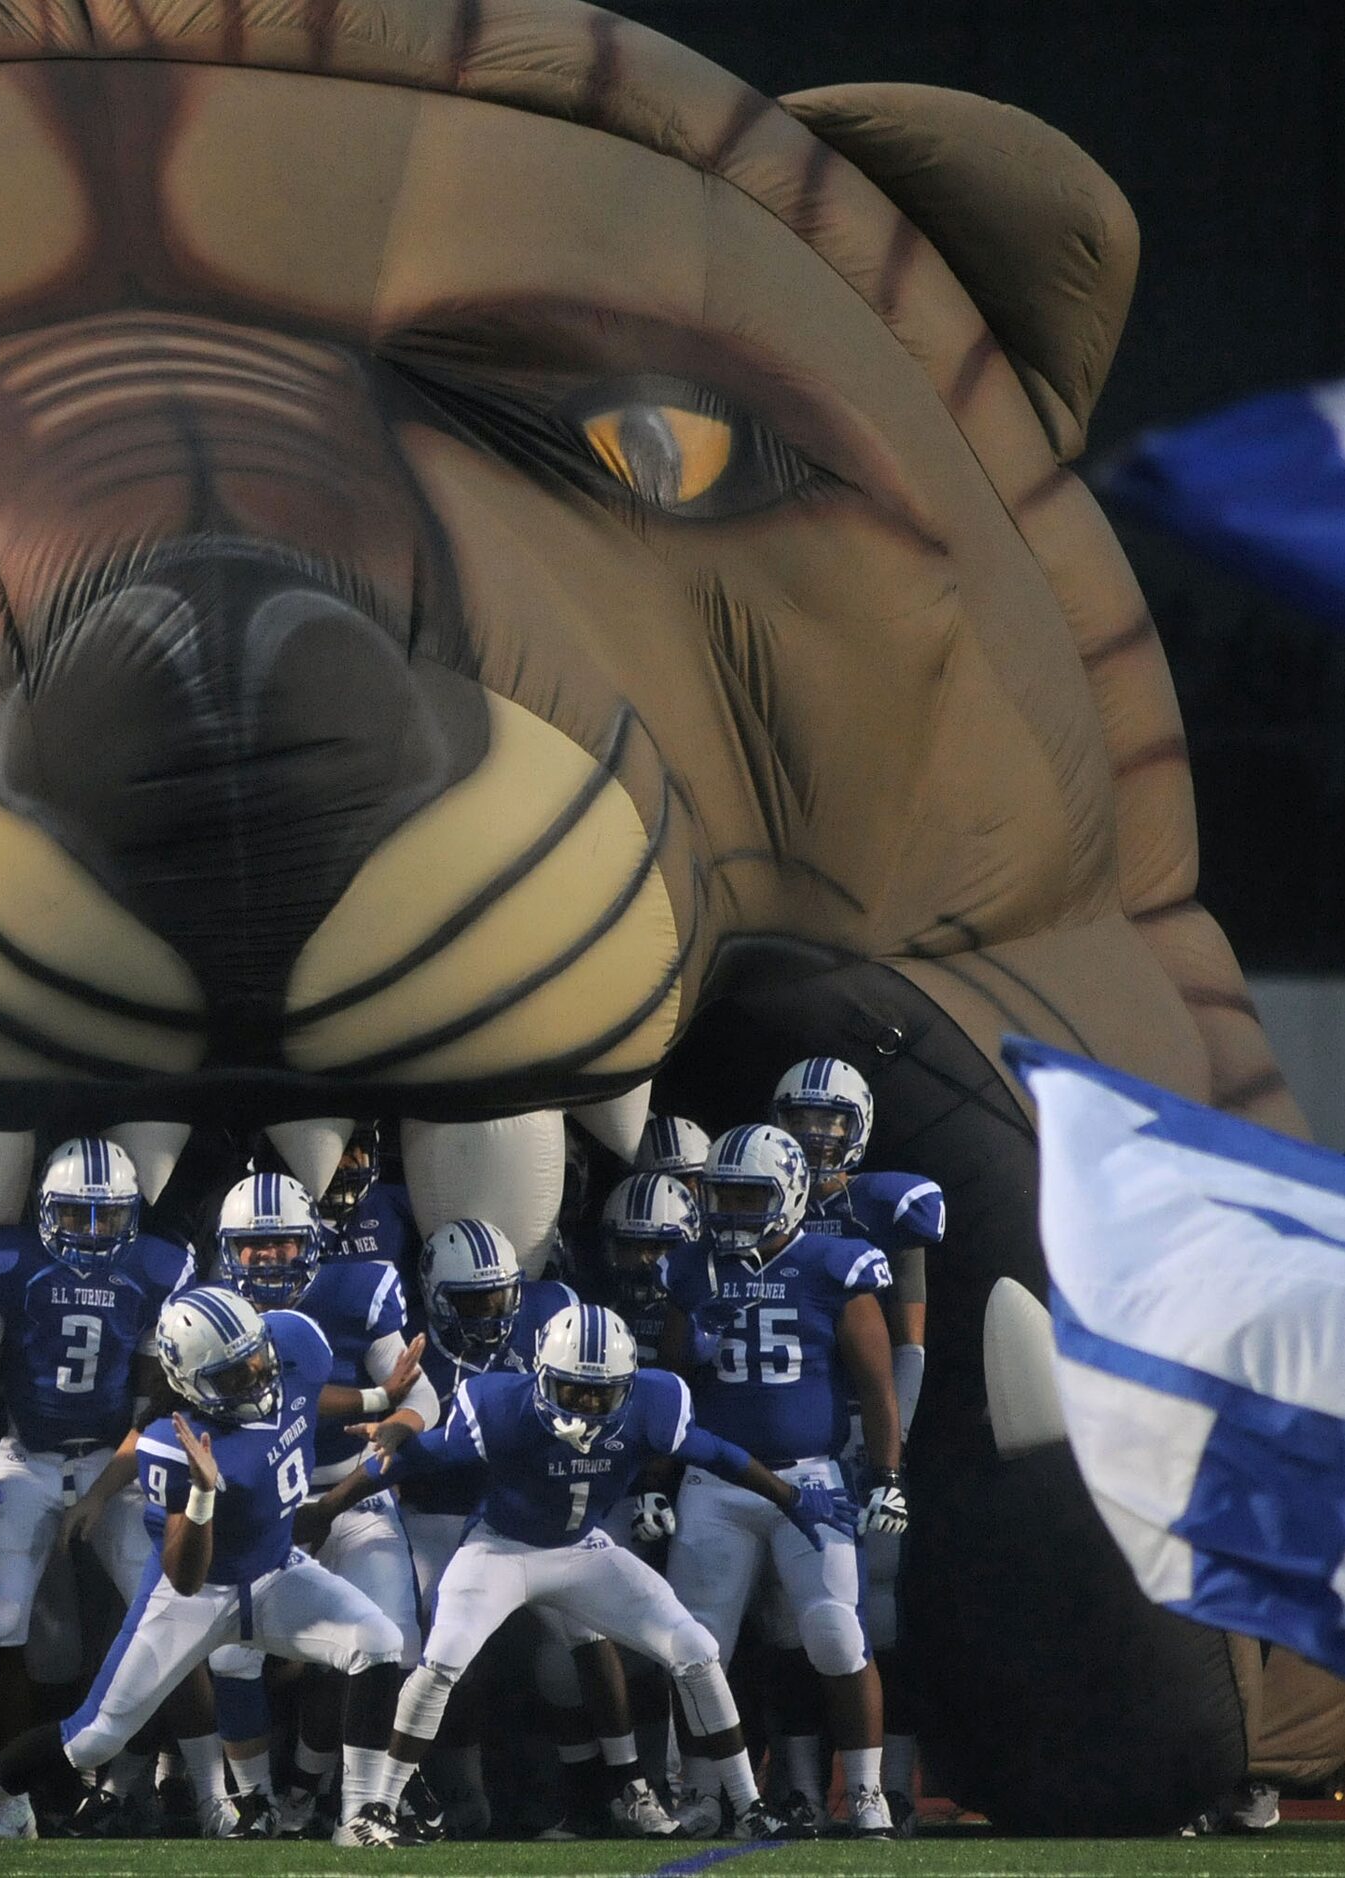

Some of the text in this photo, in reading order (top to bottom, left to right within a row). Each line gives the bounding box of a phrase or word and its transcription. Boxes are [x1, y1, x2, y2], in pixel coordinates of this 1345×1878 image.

[51, 1287, 115, 1308] R.L. TURNER
[722, 1282, 786, 1300] R.L. TURNER
[56, 1314, 102, 1393] 3
[716, 1307, 803, 1384] 65
[278, 1415, 309, 1450] TURNER
[148, 1463, 168, 1507] 9
[277, 1446, 309, 1519] 9
[548, 1458, 612, 1476] R.L. TURNER
[565, 1481, 591, 1532] 1
